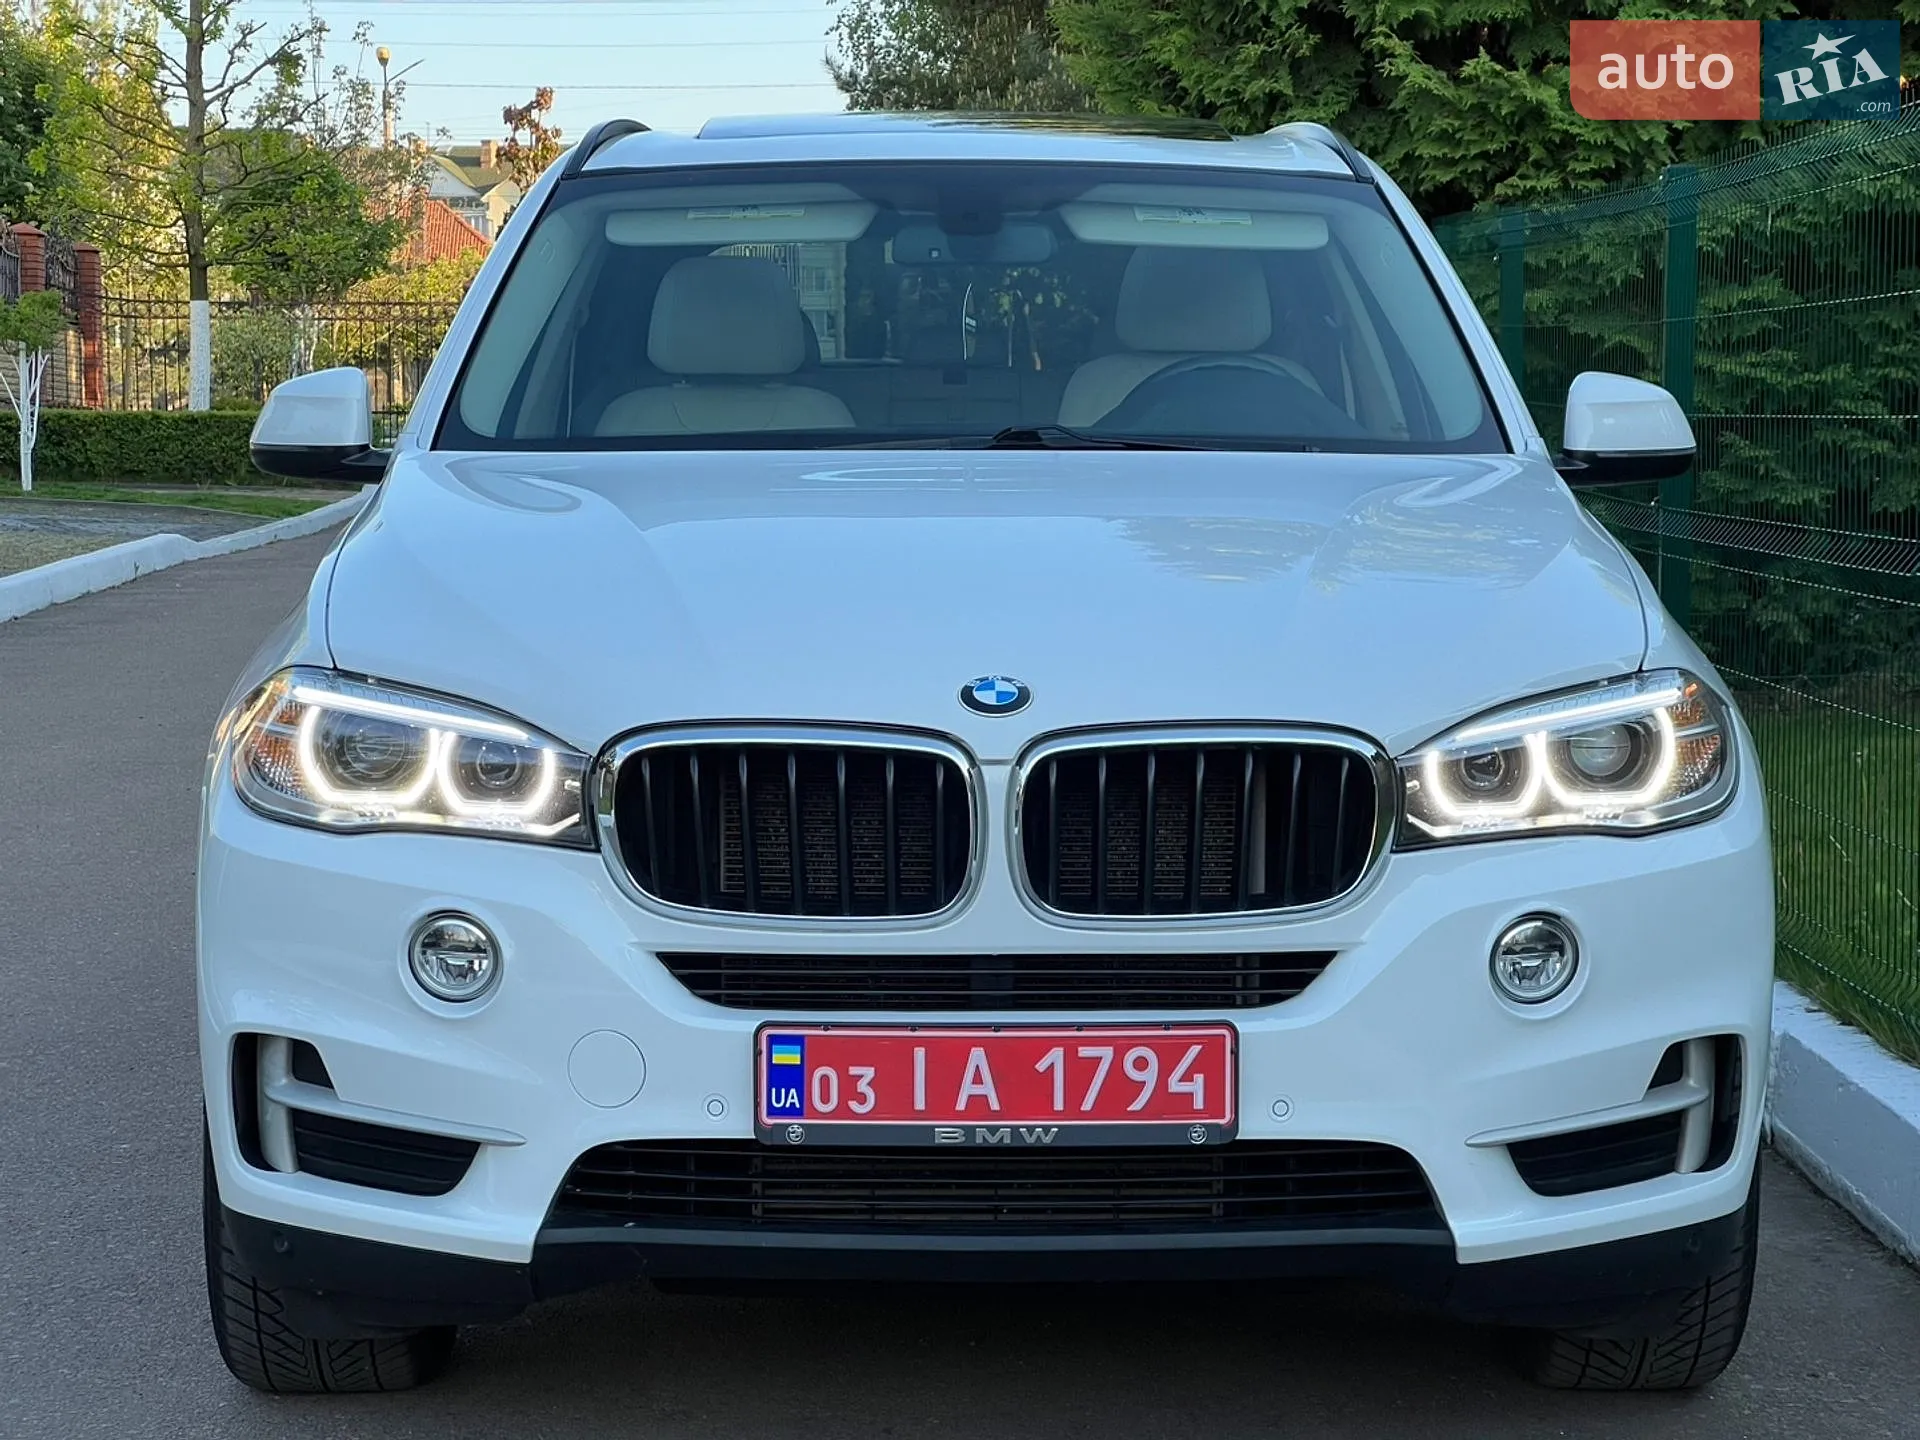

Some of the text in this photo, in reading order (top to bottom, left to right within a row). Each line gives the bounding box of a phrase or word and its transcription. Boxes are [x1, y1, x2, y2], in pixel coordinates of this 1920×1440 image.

[811, 1066, 876, 1114] 03
[1034, 1045, 1204, 1111] 1794
[771, 1087, 800, 1109] UA
[934, 1127, 1059, 1144] BMW
